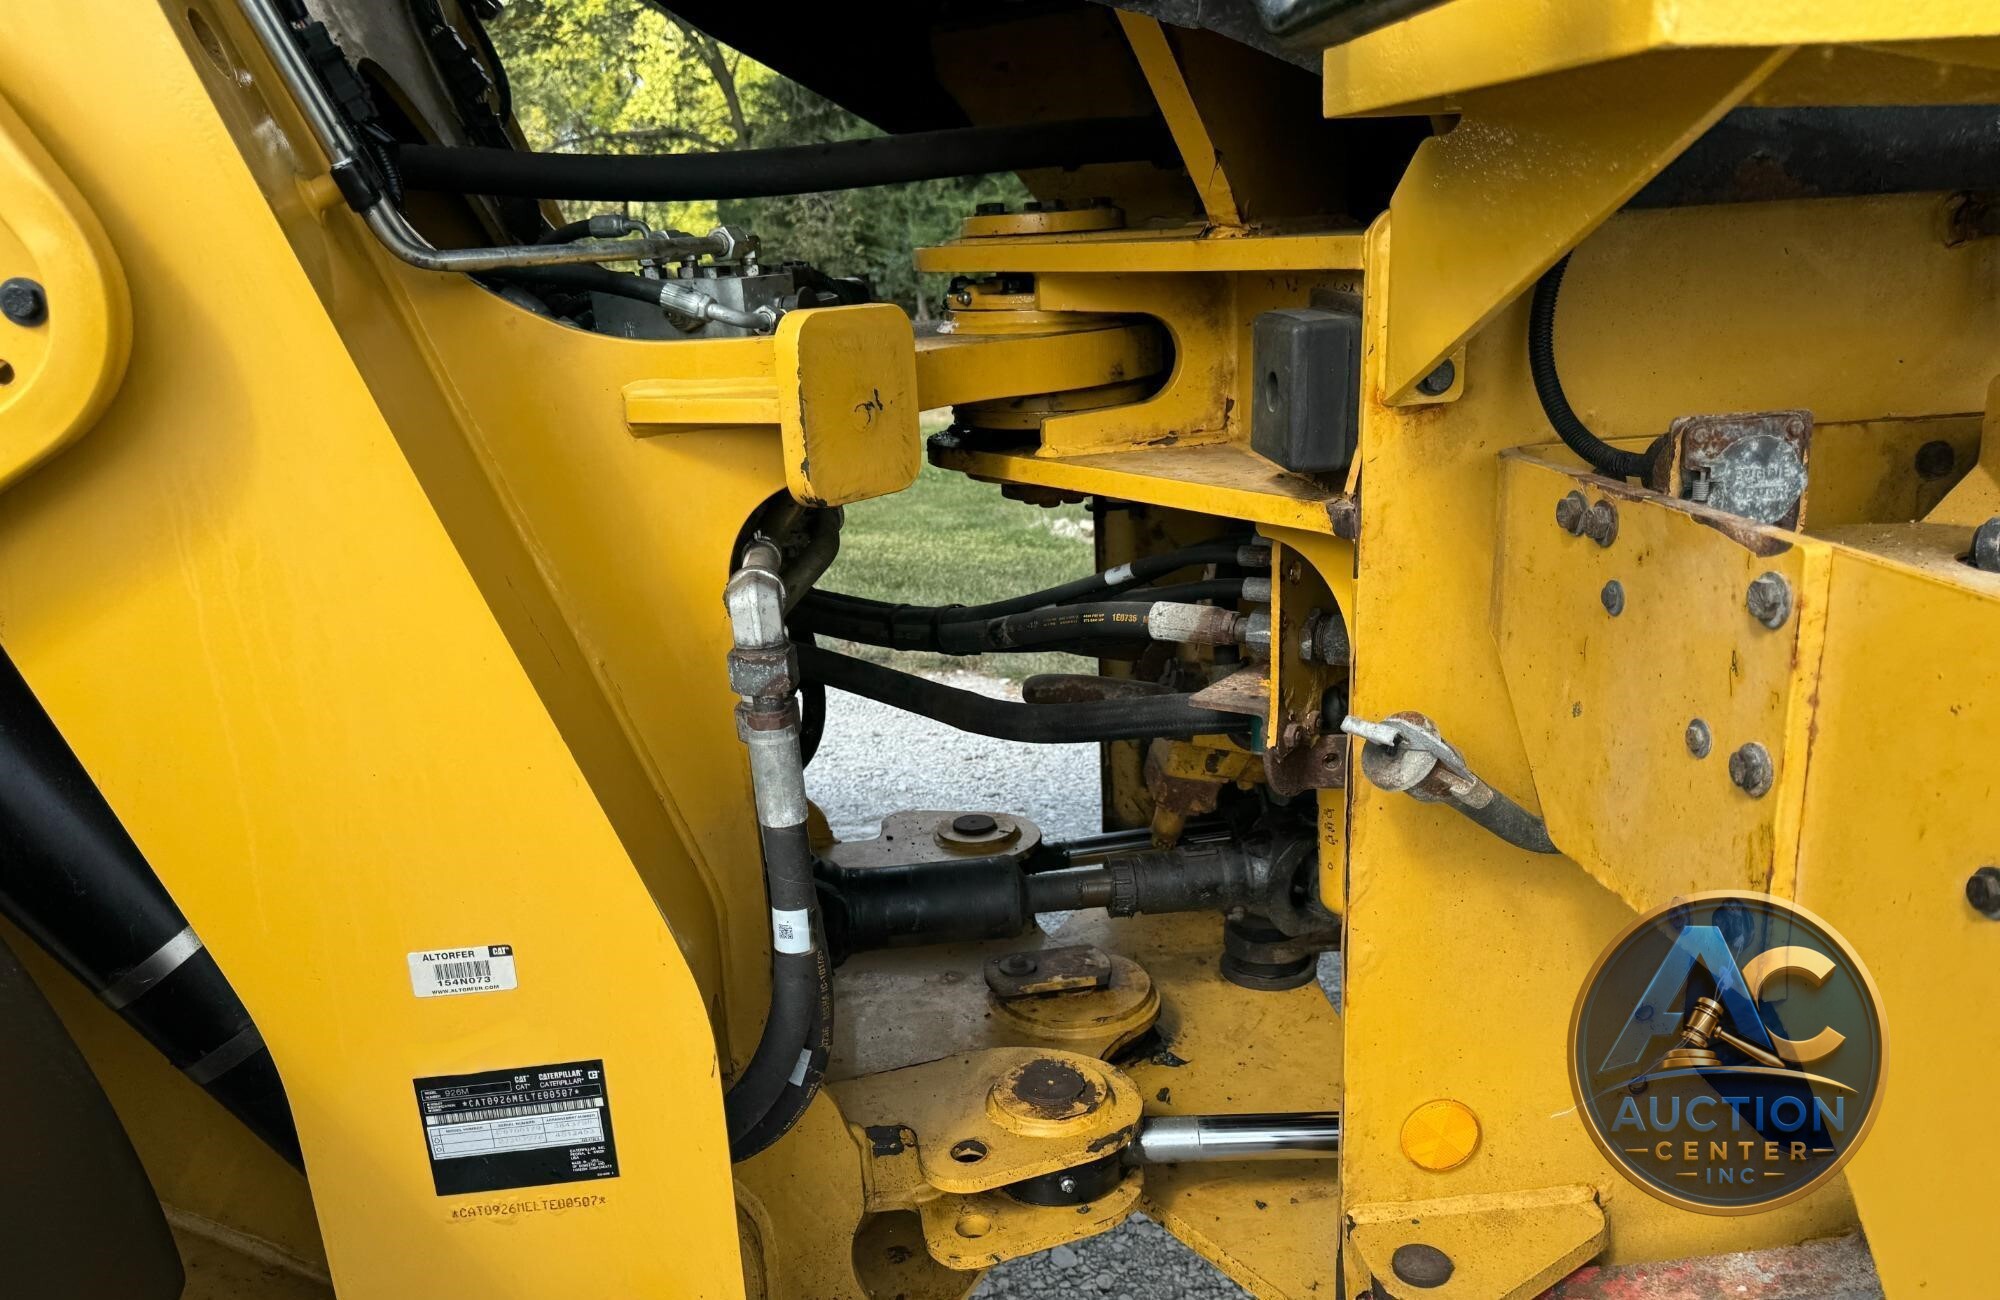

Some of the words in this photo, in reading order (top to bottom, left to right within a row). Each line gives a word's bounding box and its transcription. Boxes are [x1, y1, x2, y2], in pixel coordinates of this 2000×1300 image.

[422, 950, 476, 962] ALTORFER
[492, 947, 509, 955] CAT
[437, 976, 492, 987] 154N073
[432, 984, 500, 995] WWW.ALTORFER.COM
[514, 1075, 530, 1084] CAT
[538, 1069, 583, 1081] CATERPILLAR
[515, 1083, 531, 1091] CAT
[540, 1078, 584, 1089] CATERPILLAR
[444, 1088, 470, 1097] 926M
